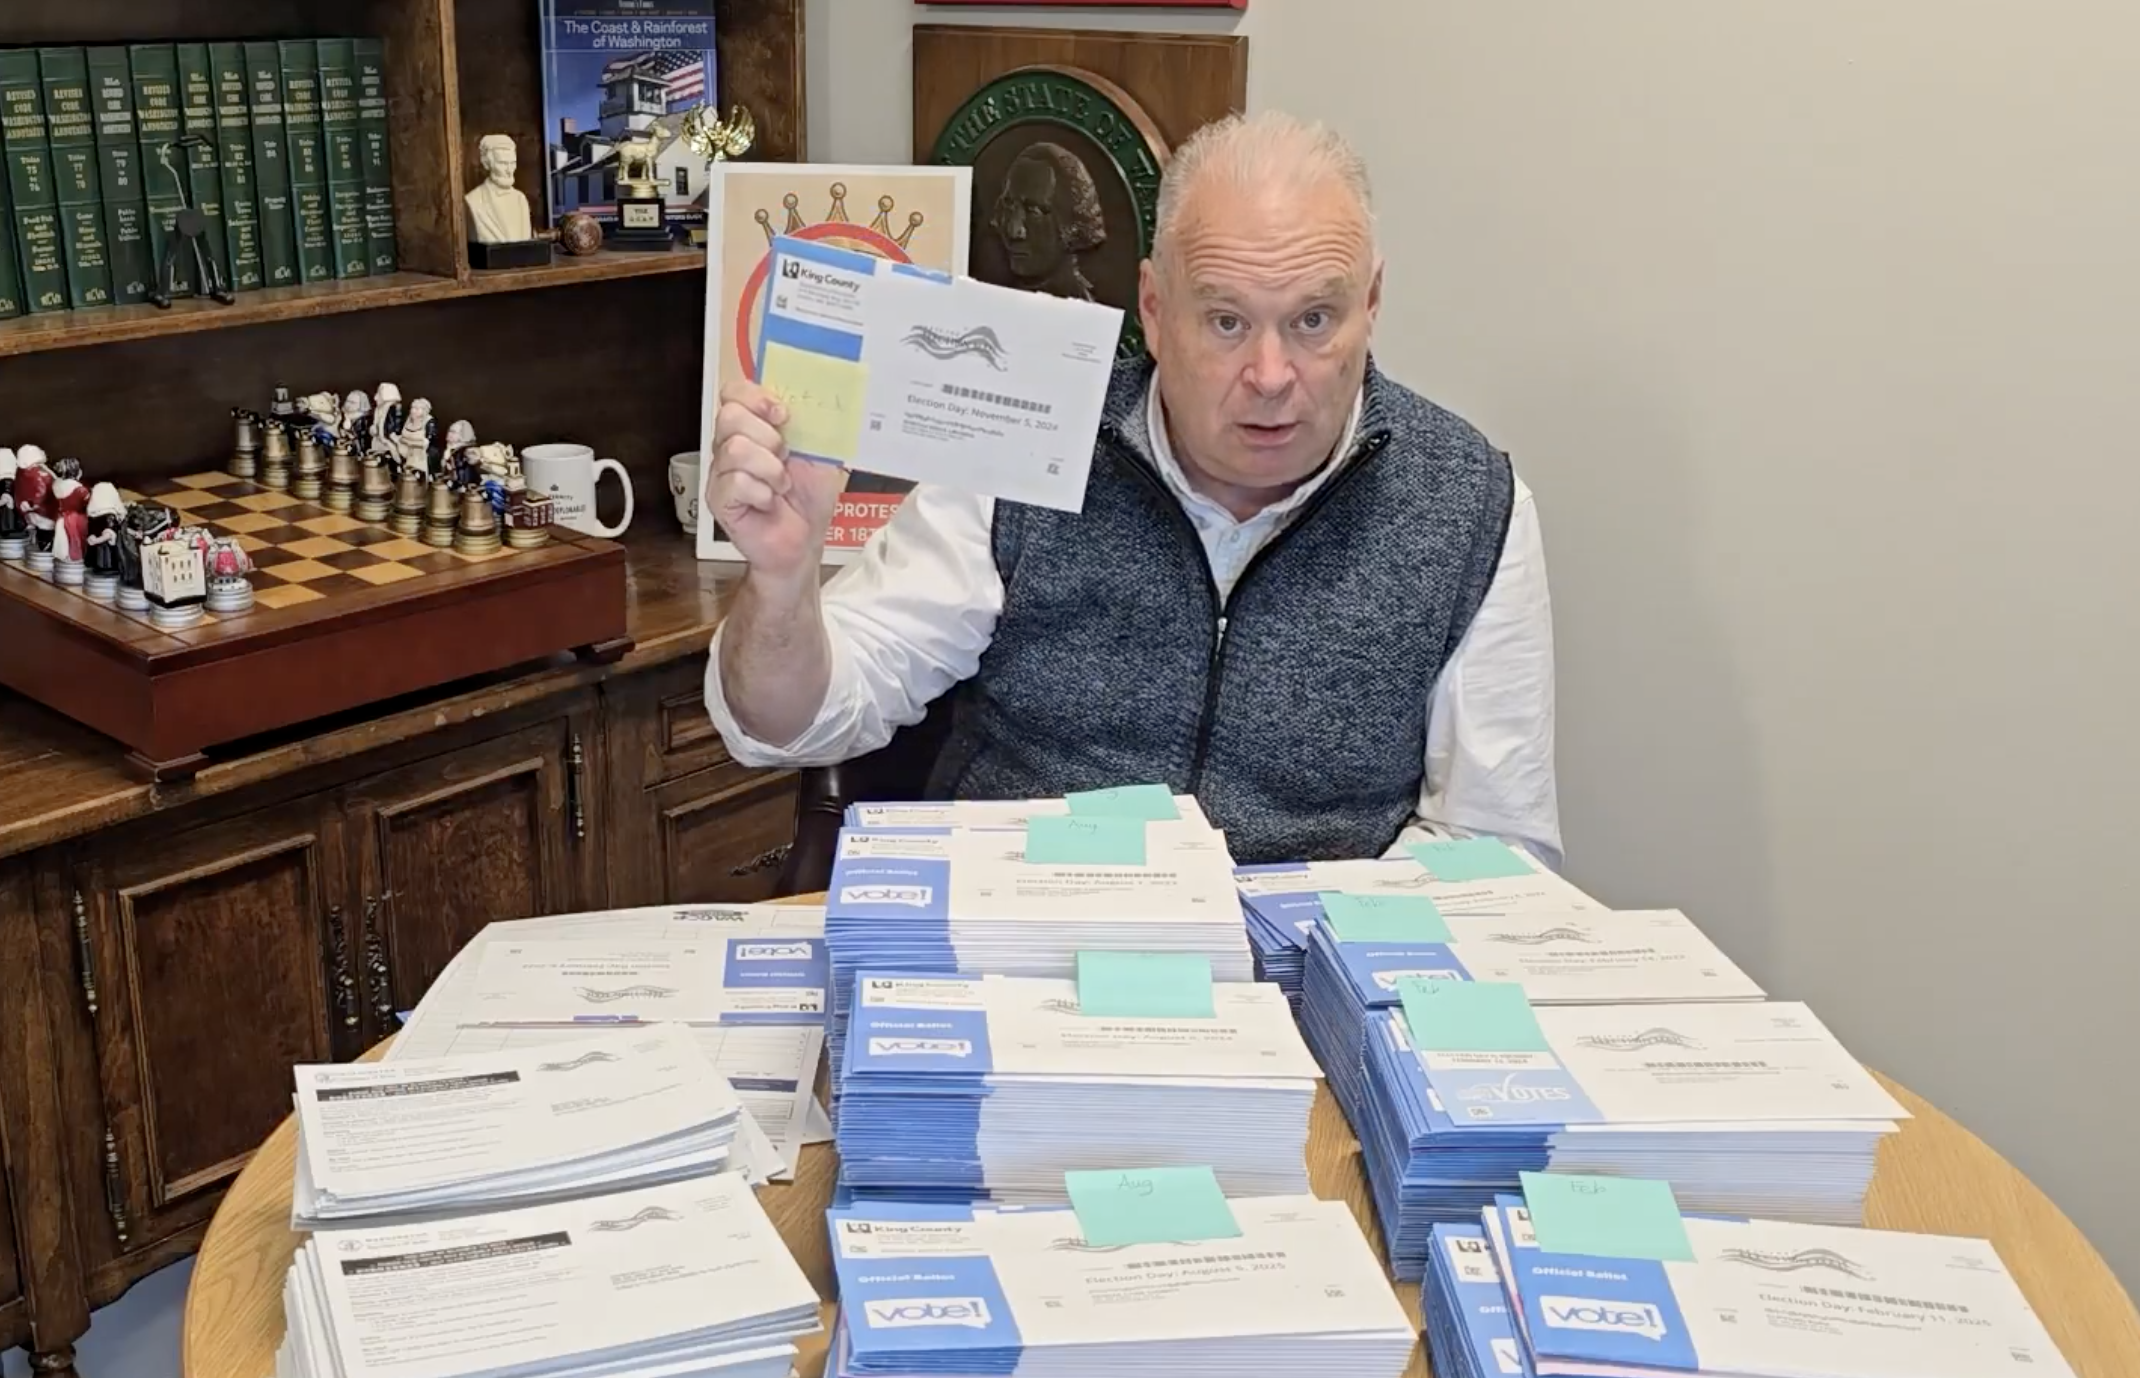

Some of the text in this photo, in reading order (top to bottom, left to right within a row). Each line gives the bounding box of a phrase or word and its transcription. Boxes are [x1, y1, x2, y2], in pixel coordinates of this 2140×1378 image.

[564, 20, 708, 34] The Coast & Rainforest
[593, 35, 682, 49] of Washington
[1004, 81, 1091, 119] STATE
[801, 268, 861, 293] King County
[907, 394, 946, 411] Election
[946, 402, 969, 416] Day:
[971, 408, 1021, 426] November
[1023, 417, 1032, 428] 5,
[1034, 419, 1060, 432] 2024
[833, 502, 899, 519] PROTES
[847, 888, 927, 901] vote!
[740, 946, 808, 957] vote!
[875, 1041, 965, 1052] vote!
[1489, 1072, 1571, 1101] VOTES
[1117, 1173, 1154, 1198] Aug
[1569, 1180, 1607, 1195] Feb
[874, 1225, 962, 1234] King County
[858, 1273, 956, 1284] Official Ballot
[1085, 1274, 1142, 1285] Election
[1145, 1271, 1179, 1280] Day:
[1182, 1266, 1232, 1277] August
[1531, 1266, 1629, 1281] Official Ballot
[871, 1301, 983, 1322] vote!
[1478, 1304, 1507, 1314] Offi
[1548, 1304, 1658, 1328] vote!
[1758, 1293, 1818, 1309] Election
[1823, 1300, 1855, 1315] Day:
[1858, 1304, 1927, 1323] February
